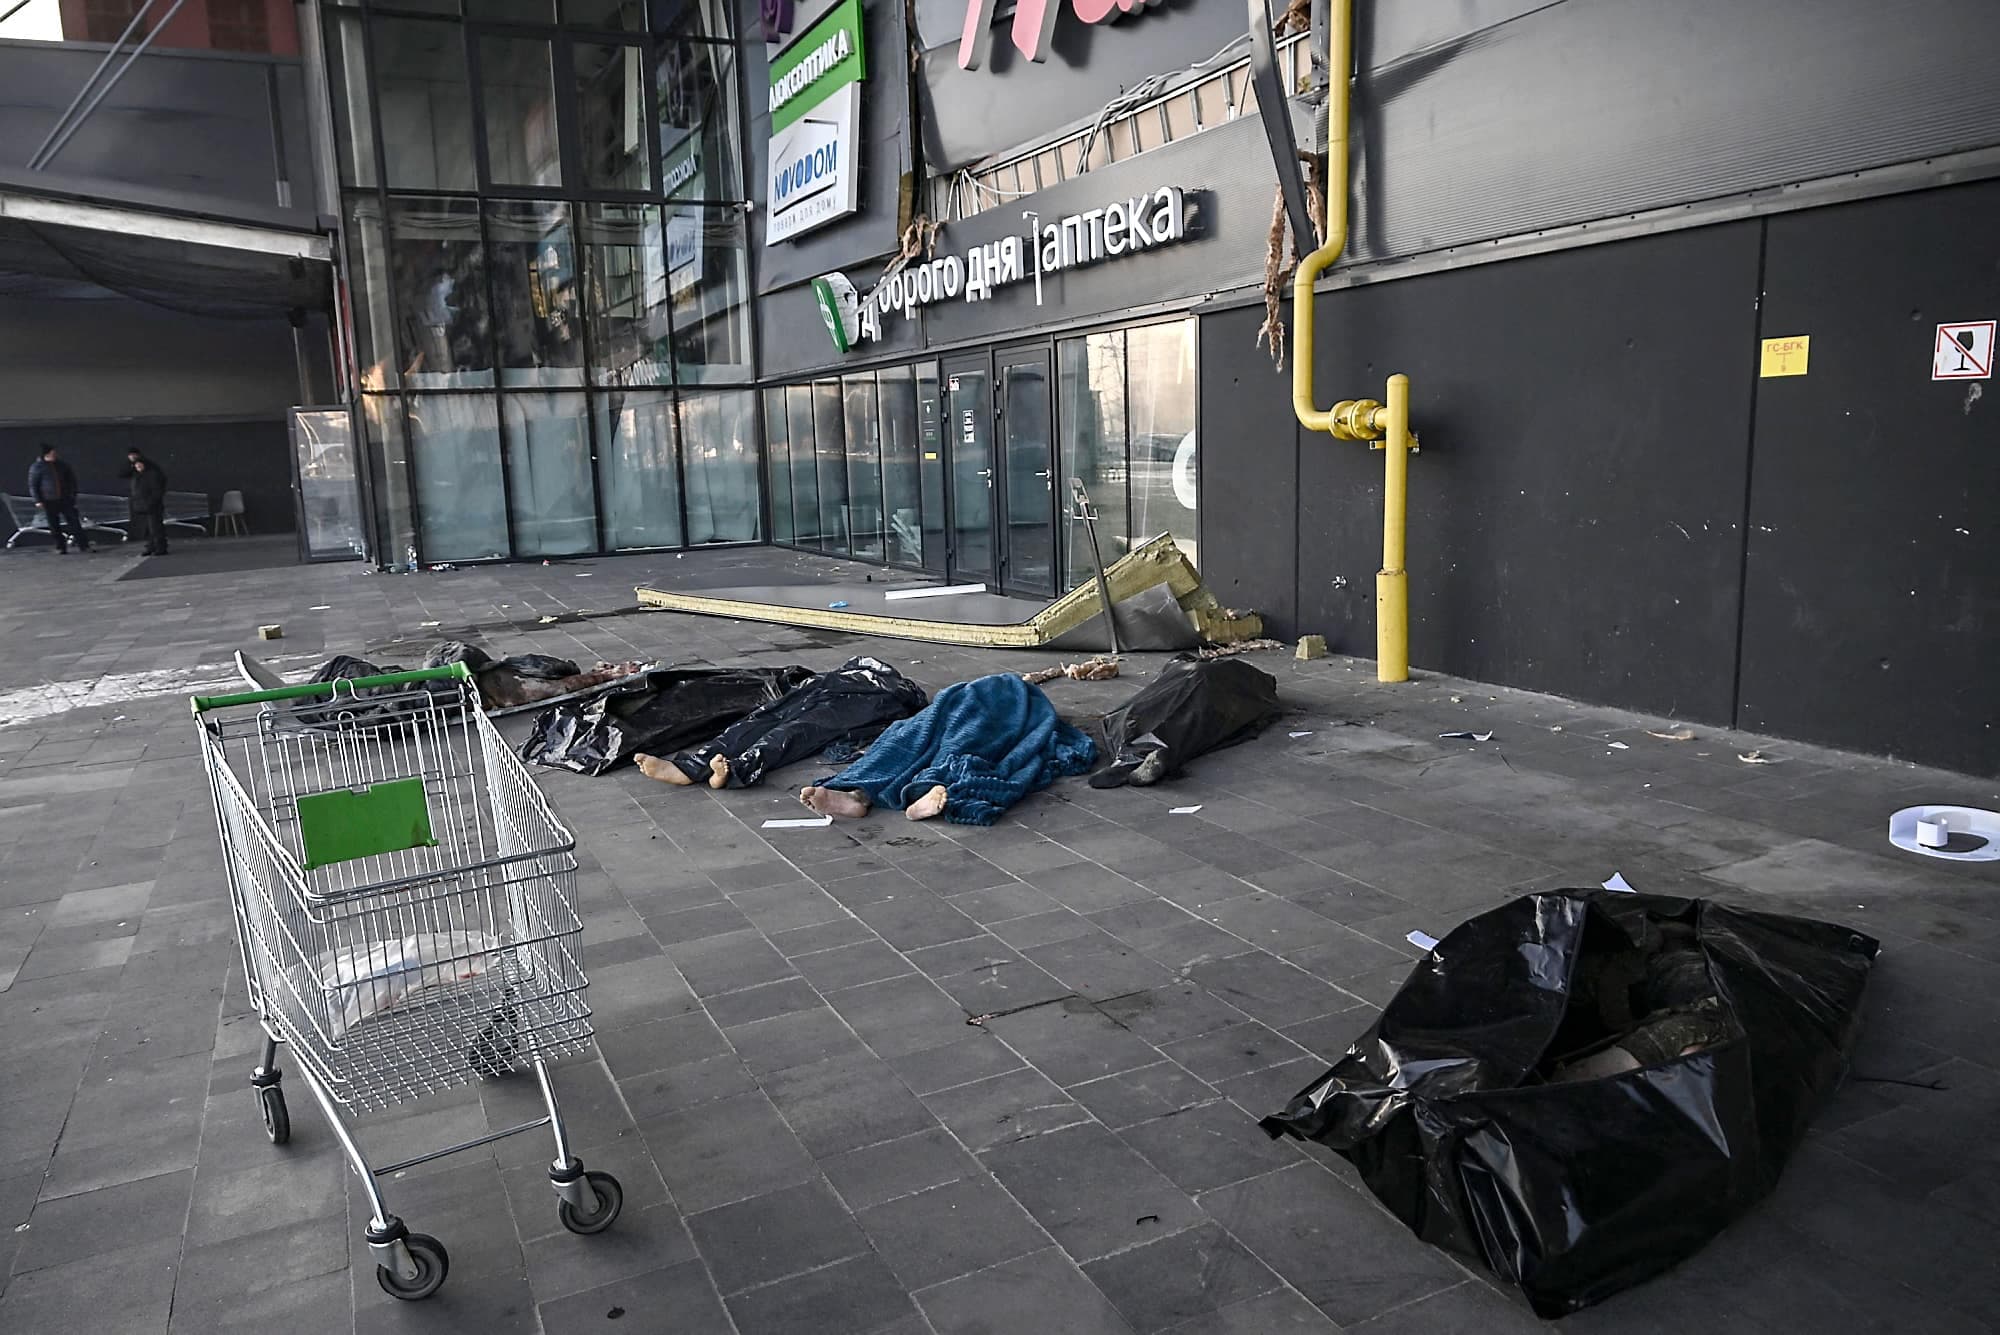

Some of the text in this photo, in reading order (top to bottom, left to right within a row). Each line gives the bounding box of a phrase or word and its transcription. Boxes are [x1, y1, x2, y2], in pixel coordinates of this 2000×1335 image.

[768, 28, 850, 113] ЛЮКСОПТИКА
[774, 140, 838, 204] NOVODOM
[965, 236, 1022, 303] дня
[1041, 186, 1182, 272] аптека
